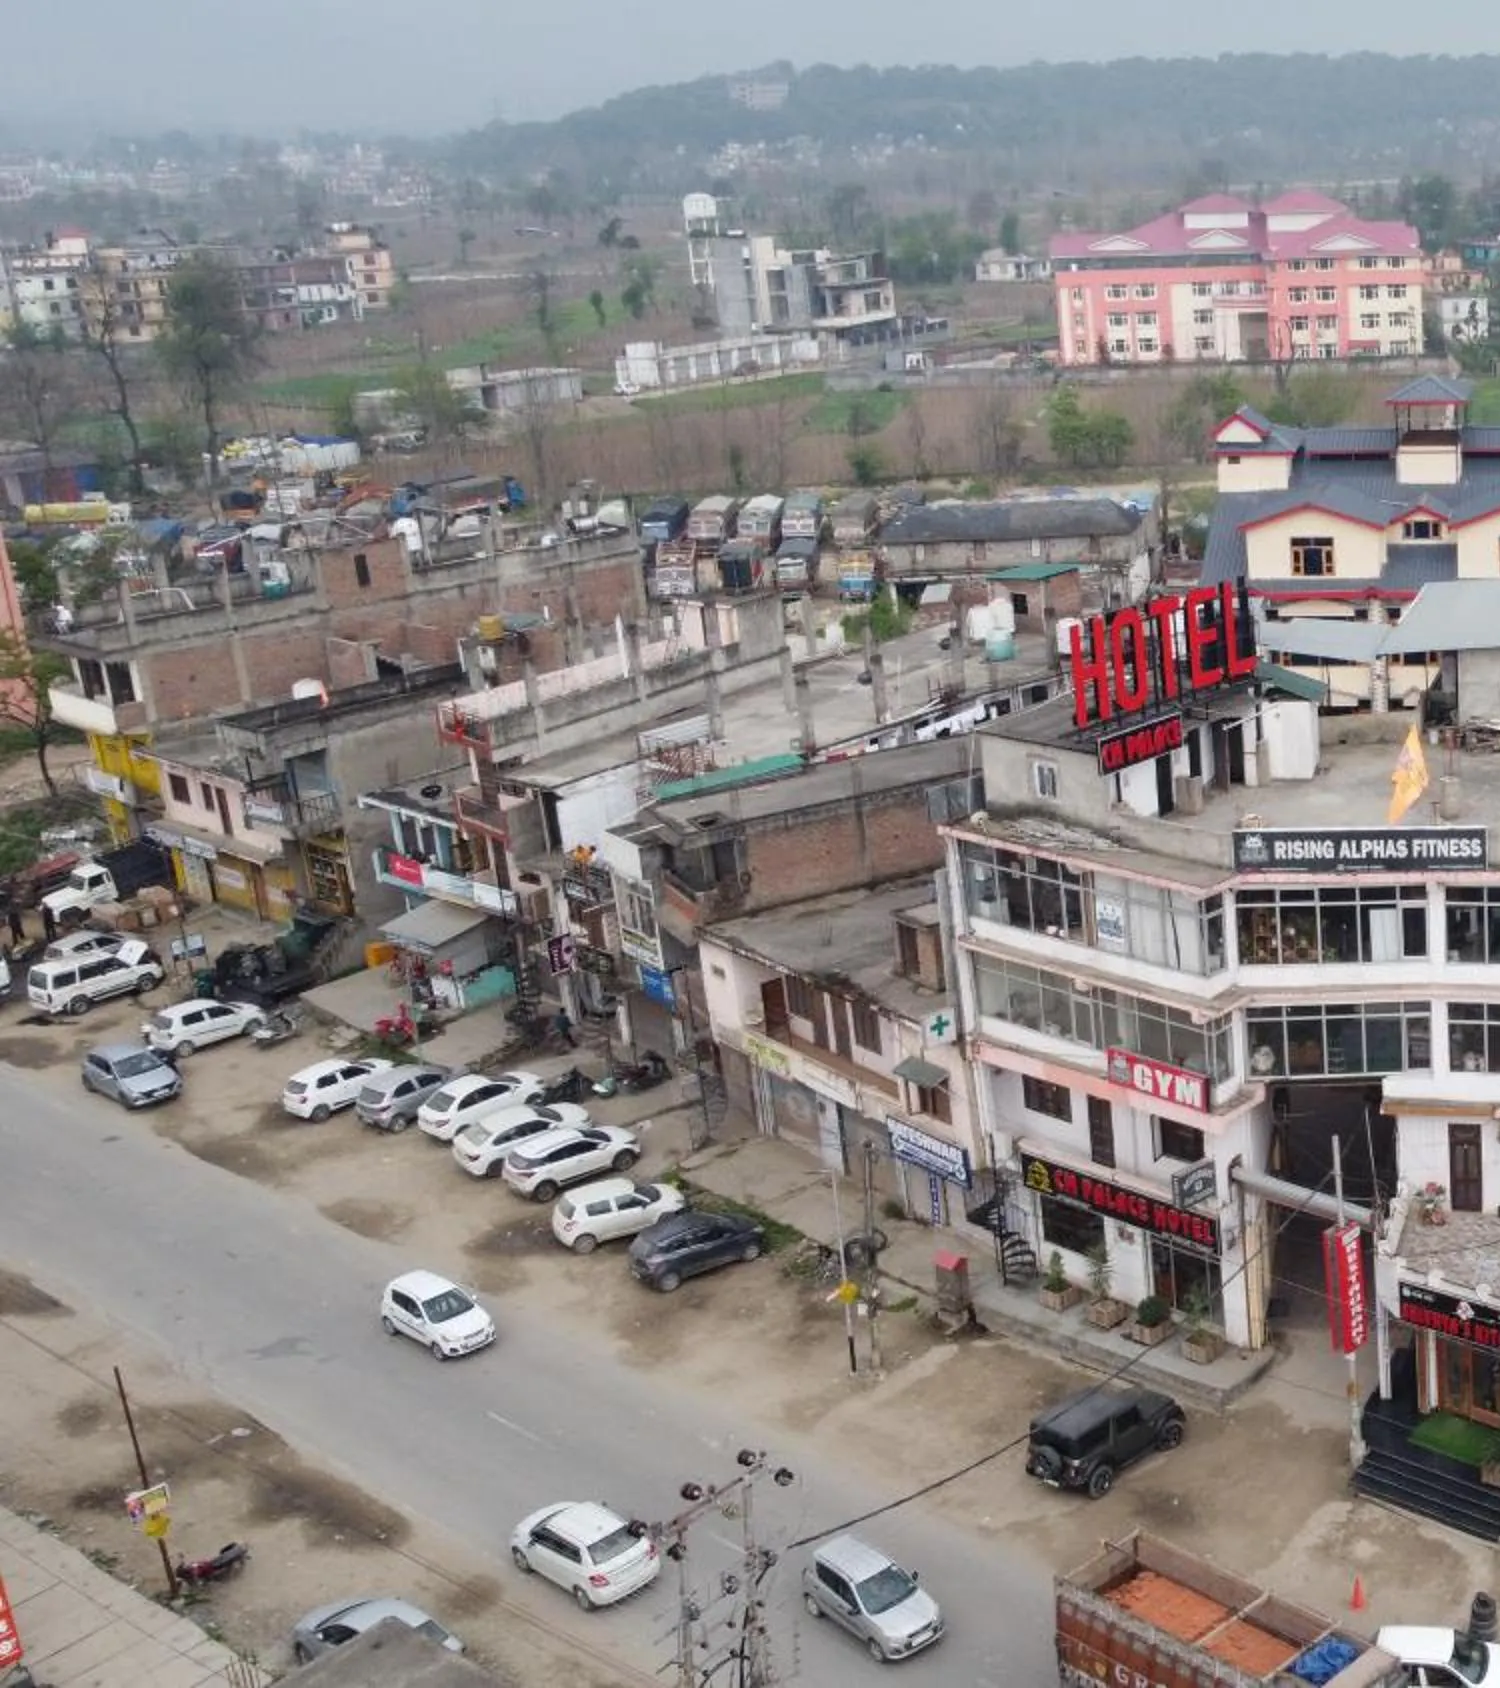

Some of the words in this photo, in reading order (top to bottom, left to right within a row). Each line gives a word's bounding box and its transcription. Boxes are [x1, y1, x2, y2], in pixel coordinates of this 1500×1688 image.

[1070, 579, 1258, 729] HOTEL
[1274, 840, 1334, 860] RISING
[1339, 839, 1409, 859] ALPHAS
[1412, 838, 1483, 858] FITNESS
[1133, 1063, 1201, 1106] GYM
[1152, 1202, 1216, 1247] HOTEL
